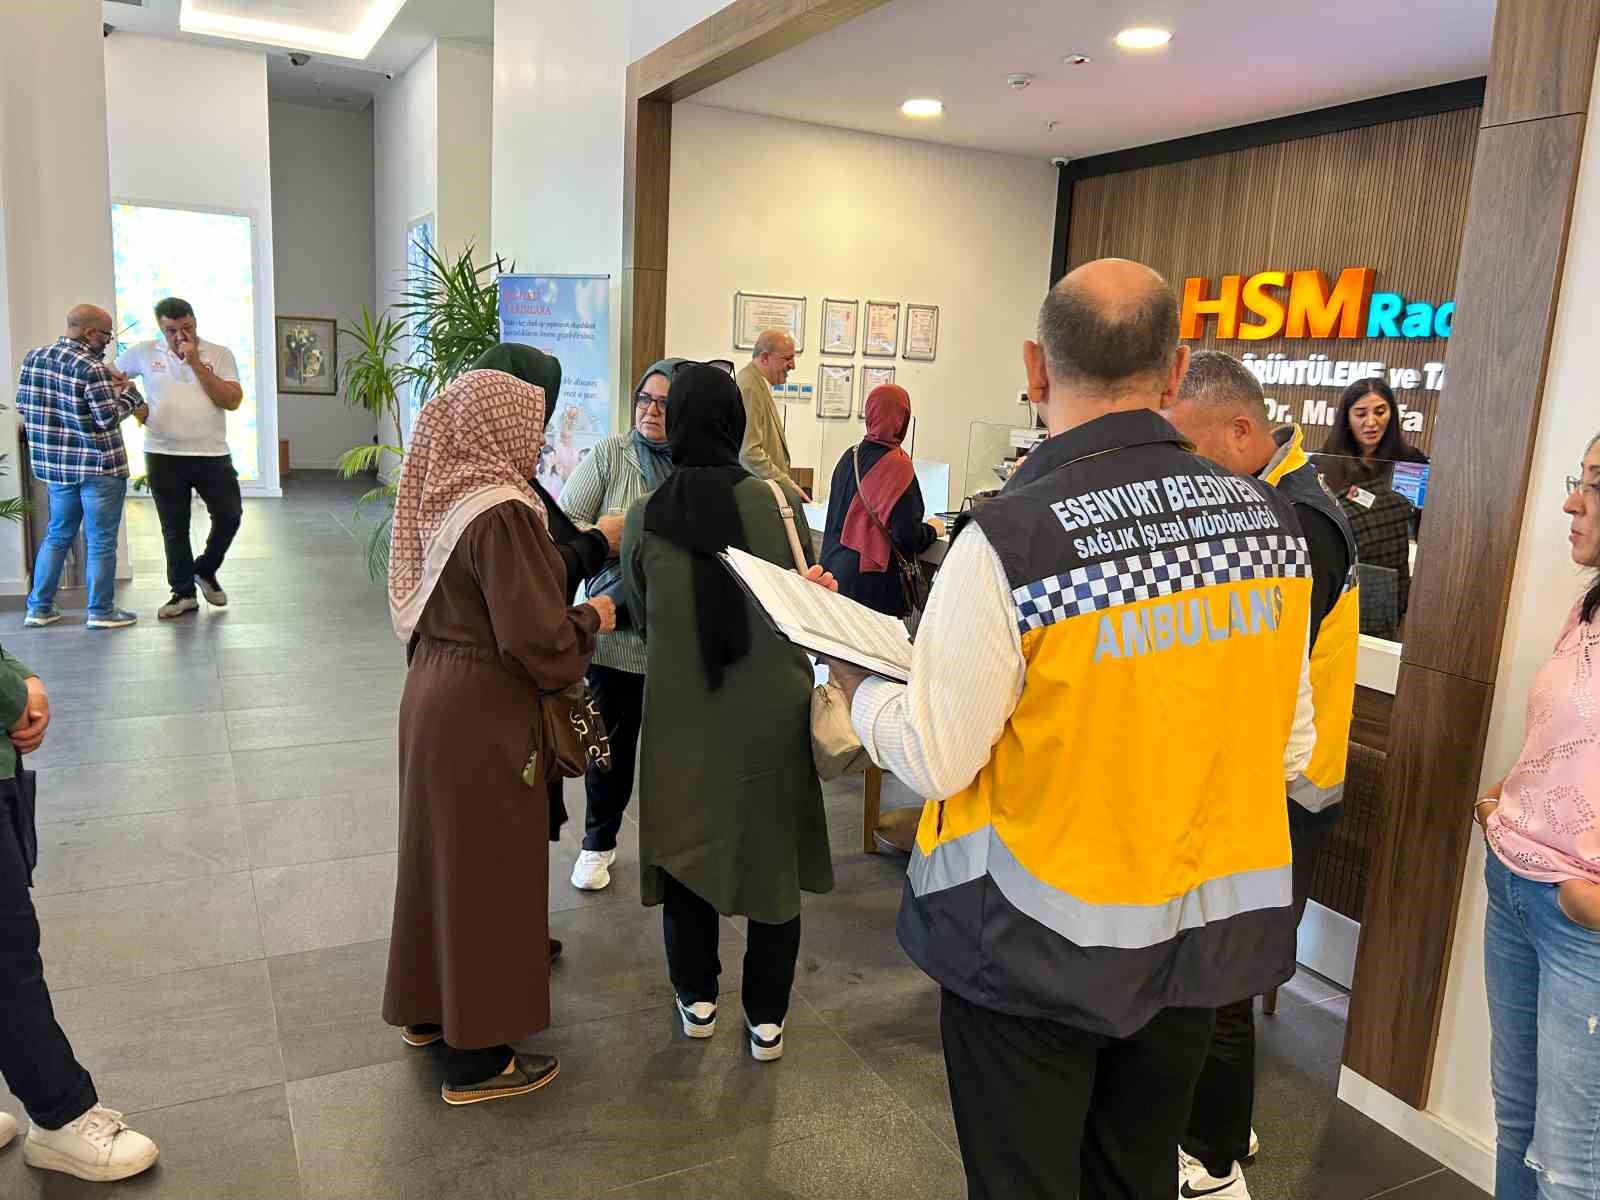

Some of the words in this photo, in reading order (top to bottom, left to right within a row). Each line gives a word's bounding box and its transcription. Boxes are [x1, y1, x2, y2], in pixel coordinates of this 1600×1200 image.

[1180, 267, 1376, 340] HSM
[1389, 367, 1422, 390] ve
[1050, 479, 1165, 532] ESENYURT
[1073, 526, 1140, 559] SAĞLIK
[1136, 514, 1190, 551] İŞLERİ
[1187, 504, 1279, 542] MÜDÜRLÜĞÜ
[1093, 585, 1284, 664] AMBULANS
